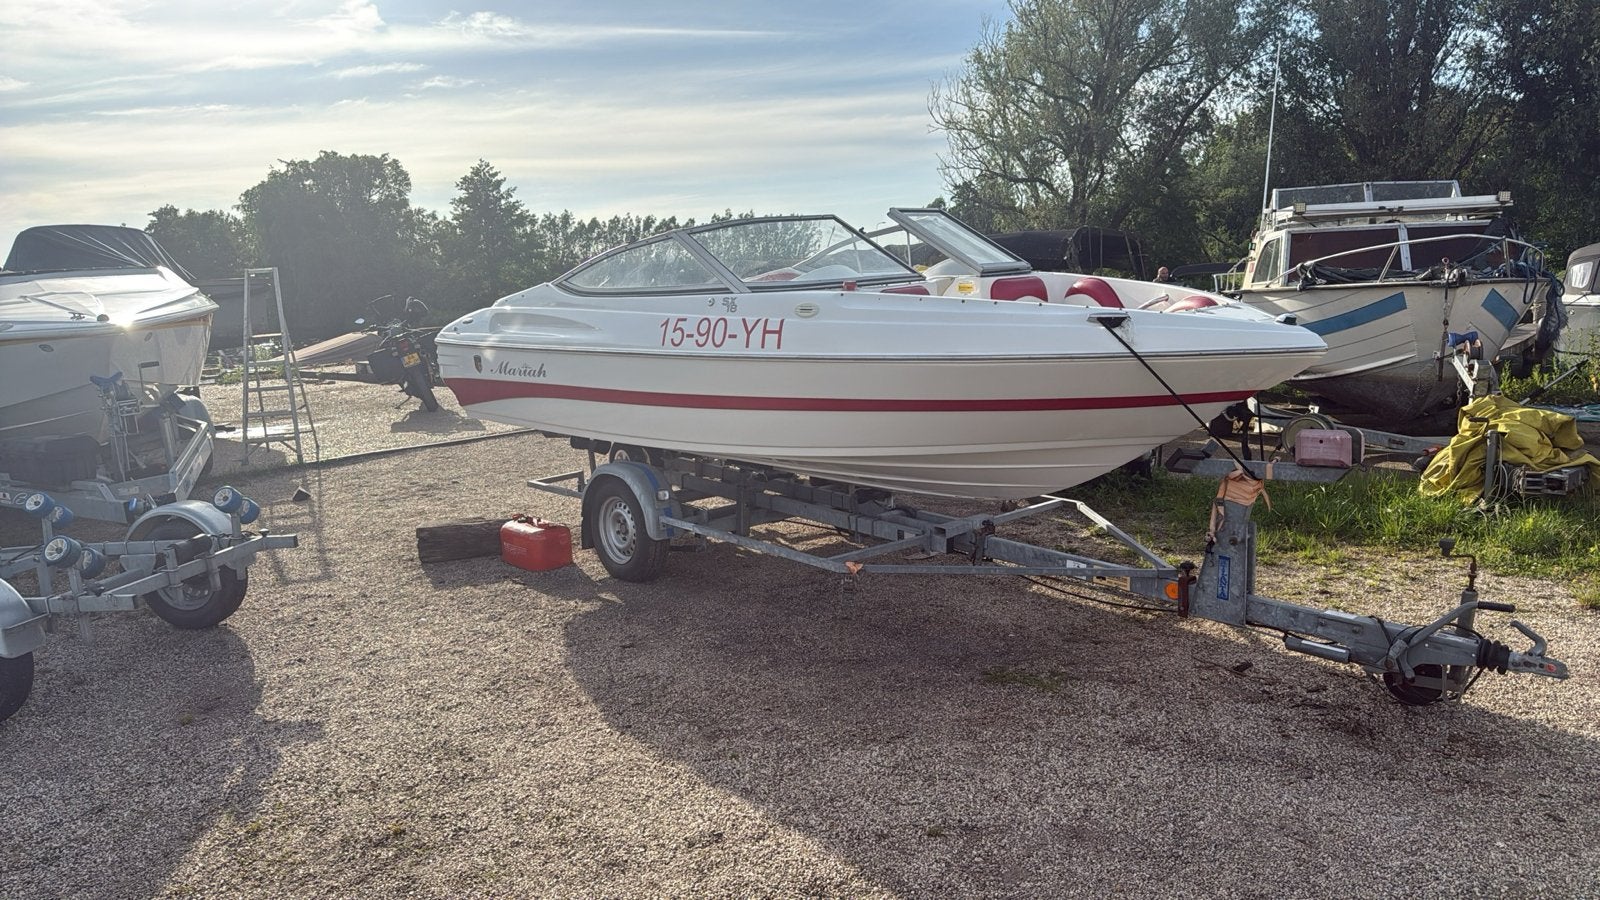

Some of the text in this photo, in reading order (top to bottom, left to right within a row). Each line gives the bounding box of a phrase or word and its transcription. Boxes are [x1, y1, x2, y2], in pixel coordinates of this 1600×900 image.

[726, 304, 738, 313] 18
[660, 317, 785, 350] 15-90-YH
[490, 360, 548, 378] Mariah
